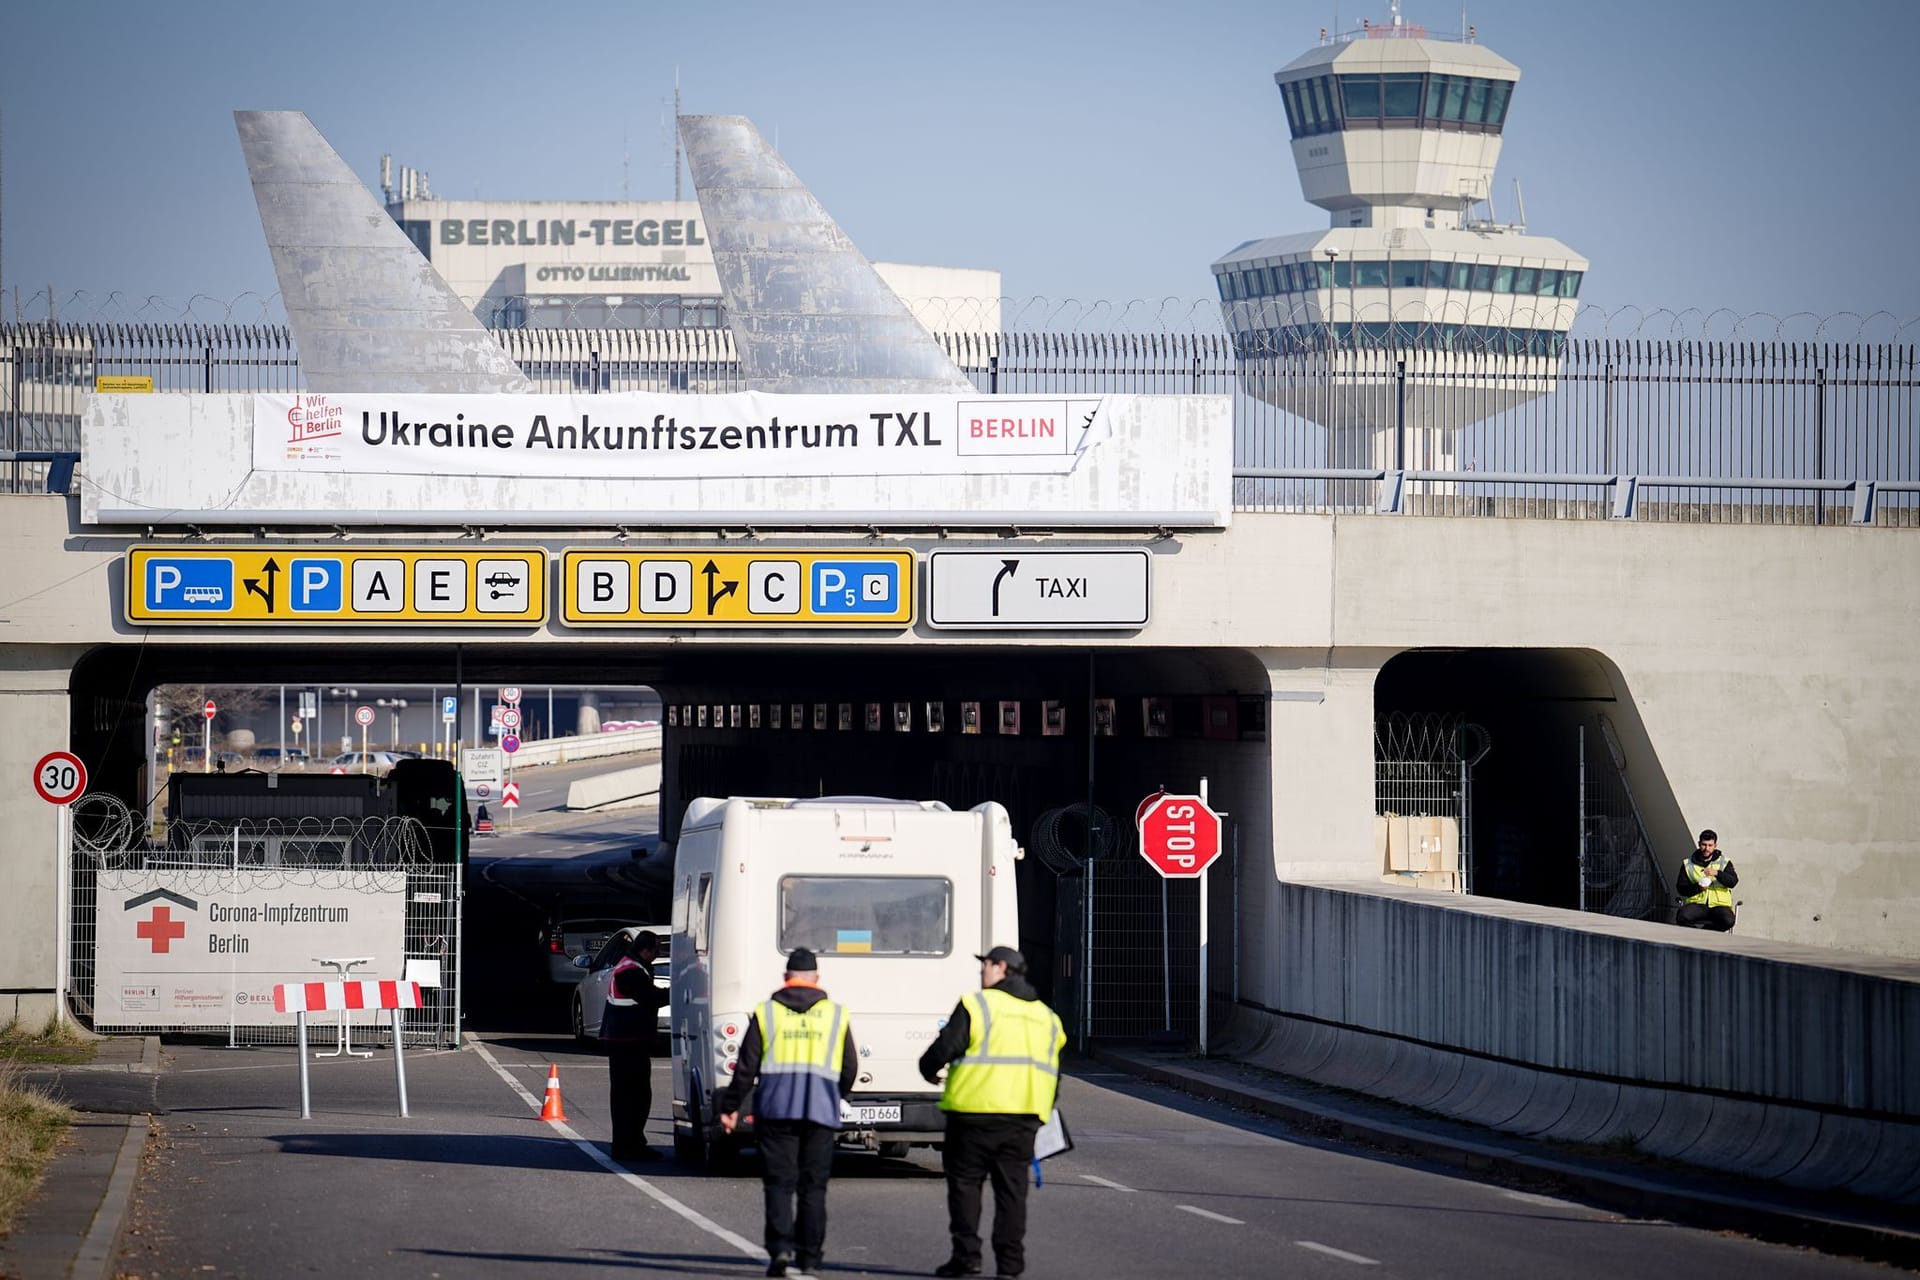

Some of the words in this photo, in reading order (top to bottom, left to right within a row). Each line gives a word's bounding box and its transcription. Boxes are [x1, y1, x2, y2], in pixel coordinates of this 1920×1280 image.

[440, 219, 705, 247] BERLIN-TEGEL
[536, 266, 584, 282] OTTO
[588, 264, 691, 282] LILIENTHAL
[306, 395, 326, 407] Wir
[306, 406, 343, 421] helfen
[306, 418, 342, 433] Berlin
[362, 411, 514, 449] Ukraine
[526, 412, 858, 451] Ankunftszentrum
[870, 412, 942, 447] TXL
[970, 418, 1054, 438] BERLIN
[156, 566, 182, 604] P
[303, 567, 330, 604] P
[366, 571, 391, 600] A
[430, 571, 451, 600] E
[593, 572, 614, 601] B
[655, 573, 677, 601] D
[764, 573, 785, 602] C
[870, 580, 881, 595] C
[1036, 578, 1087, 598] TAXI
[360, 711, 370, 720] 30
[446, 700, 453, 712] P
[505, 714, 516, 723] 30
[45, 765, 75, 790] 30
[1166, 805, 1195, 868] STOP
[209, 903, 349, 926] Corona-Impfzentrum
[209, 934, 249, 954] Berlin
[860, 1108, 876, 1120] RD
[877, 1108, 899, 1120] 666
